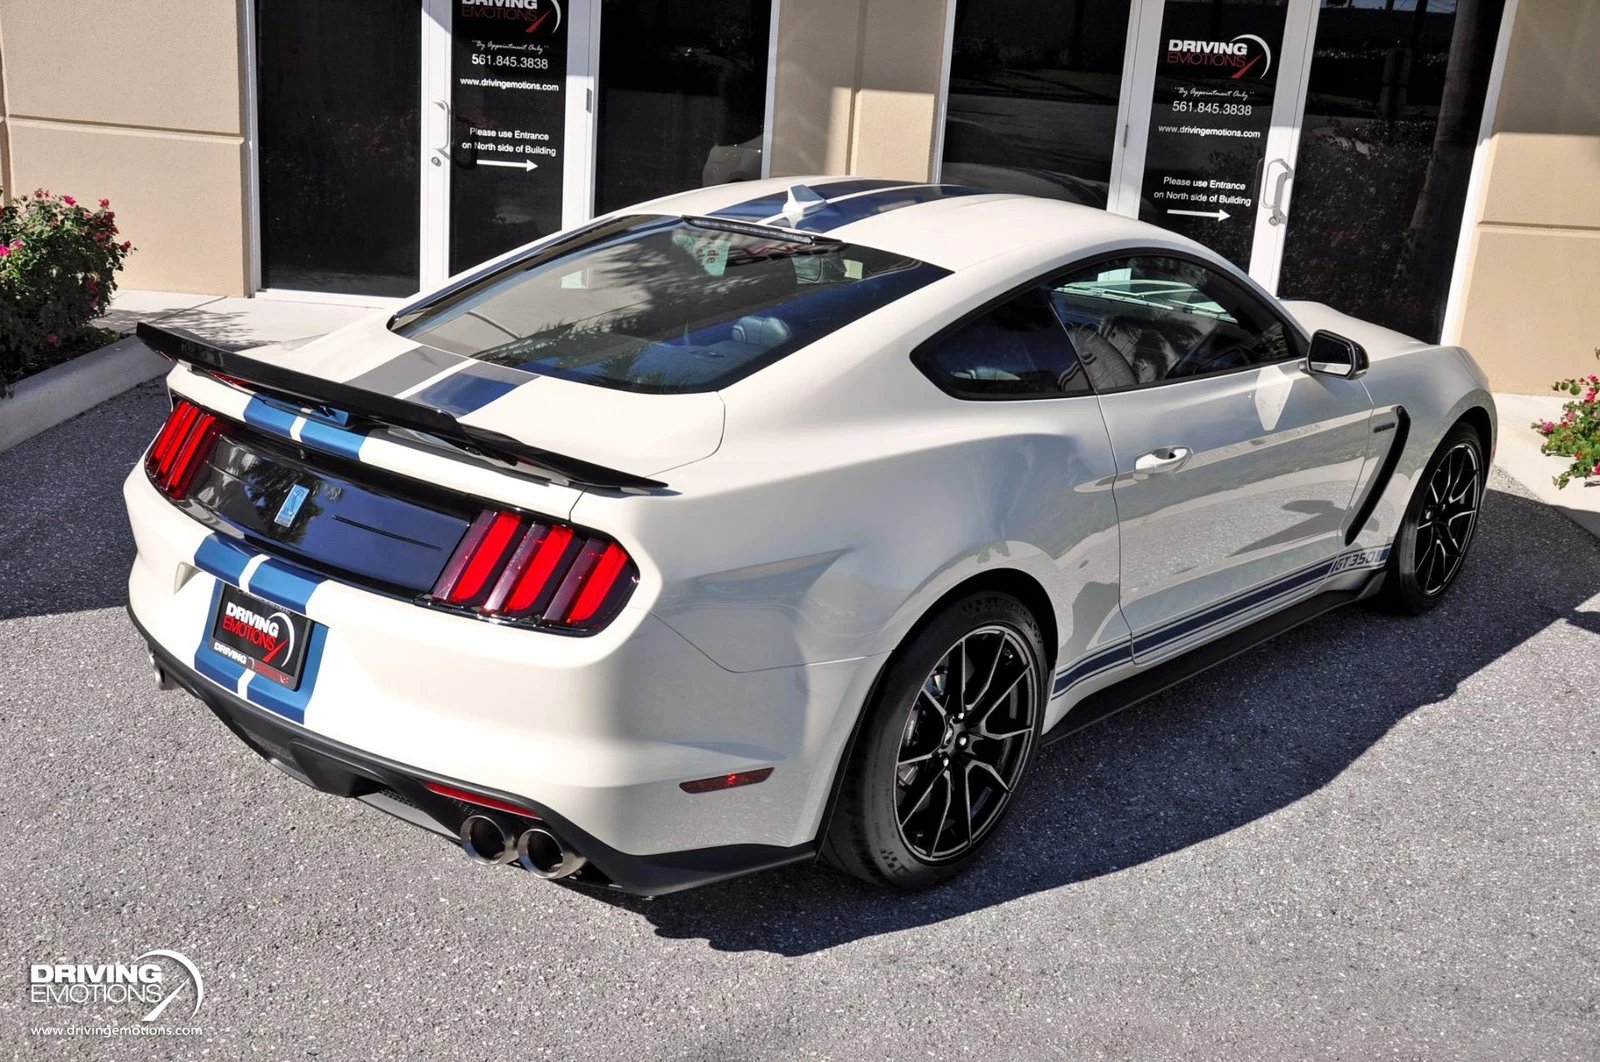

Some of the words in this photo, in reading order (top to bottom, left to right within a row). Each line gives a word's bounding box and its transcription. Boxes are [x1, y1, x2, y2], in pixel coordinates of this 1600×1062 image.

[461, 5, 537, 21] EMOTIONS
[487, 41, 527, 50] Appointment
[1168, 39, 1248, 56] DRIVING
[471, 53, 549, 69] 561.845.3838
[1167, 51, 1247, 67] EMOTIONS
[460, 78, 559, 91] www.drivingemotions.com
[1190, 88, 1232, 97] Appointment
[1172, 101, 1252, 116] 561.845.3838
[469, 127, 497, 137] Please
[514, 130, 549, 140] Entrance
[1158, 125, 1261, 138] www.drivingemotions.com
[474, 142, 496, 151] North
[497, 144, 514, 152] side
[515, 145, 523, 153] of
[525, 145, 557, 157] Building
[1163, 176, 1191, 186] Please
[1209, 180, 1246, 190] Entrance
[1166, 191, 1189, 200] North
[1190, 193, 1207, 202] side
[1219, 195, 1252, 207] Building
[225, 601, 279, 638] DRIVING
[222, 615, 276, 651] EMOTIONS
[213, 641, 247, 665] DRIVING
